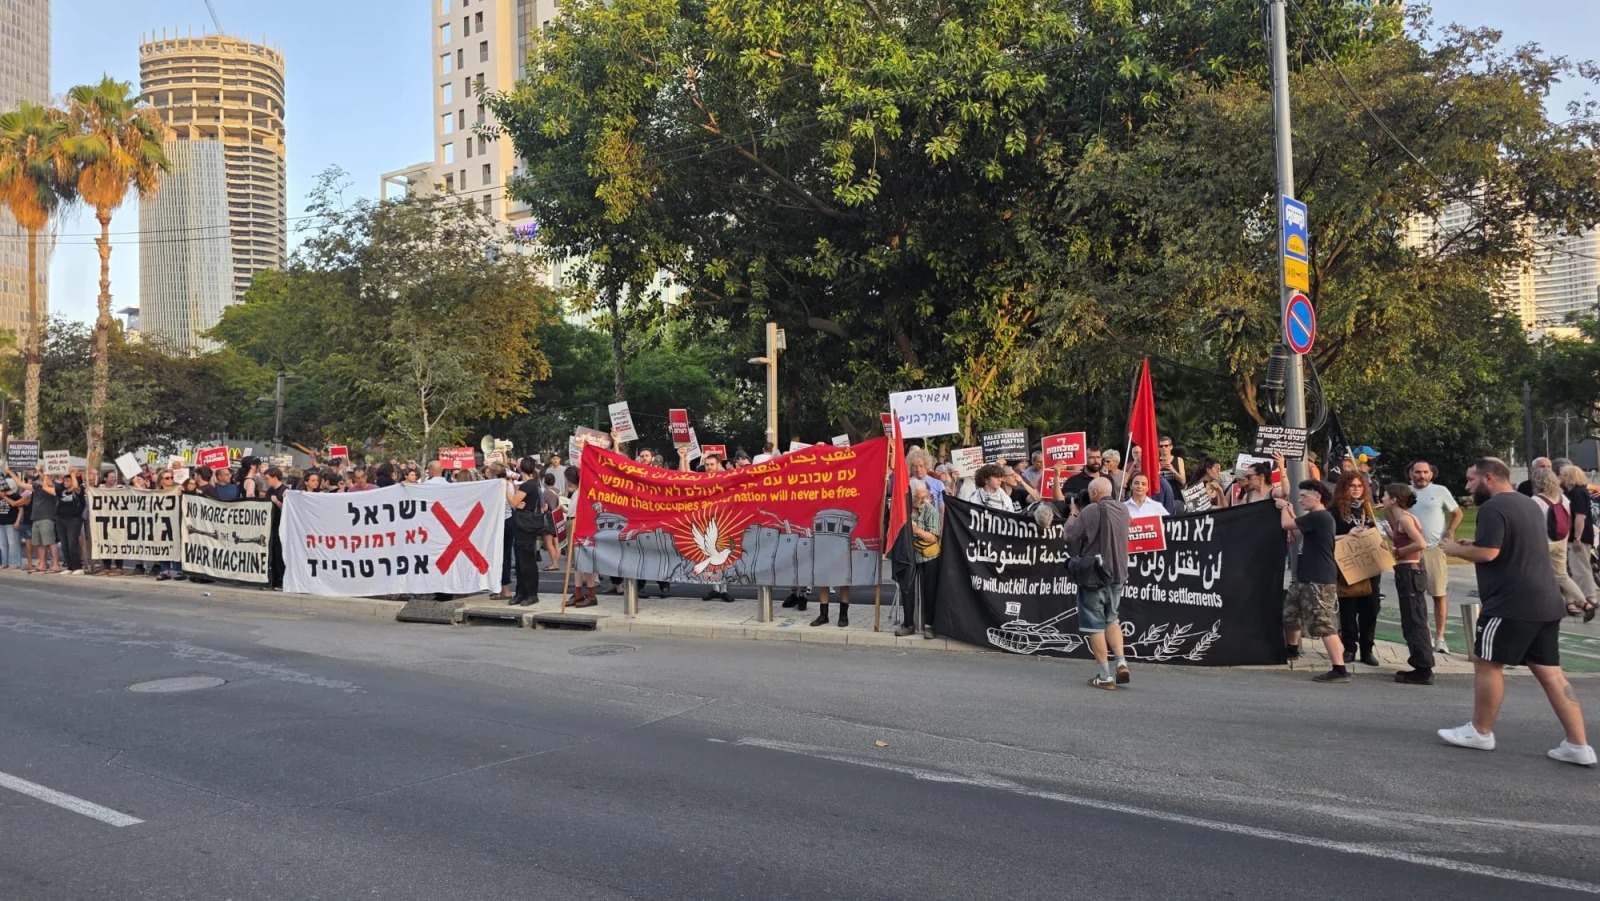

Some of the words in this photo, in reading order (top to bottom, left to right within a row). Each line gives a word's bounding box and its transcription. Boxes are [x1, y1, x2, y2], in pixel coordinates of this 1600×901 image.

[904, 393, 950, 404] משמידים
[983, 432, 1024, 442] PALESTINIAN
[1258, 426, 1284, 434] לכיבוש
[763, 476, 782, 486] עם
[787, 475, 833, 485] שכובש
[838, 468, 857, 481] עם
[587, 487, 599, 500] A
[598, 490, 630, 507] nation
[631, 494, 654, 511] that
[653, 502, 699, 513] occupies
[733, 491, 767, 503] nation
[769, 489, 788, 501] will
[790, 489, 820, 501] never
[821, 485, 836, 499] be
[665, 484, 681, 497] לא
[686, 483, 723, 497] לעולם
[92, 495, 147, 511] מייצאים
[149, 495, 176, 513] כאן
[347, 499, 427, 526] ישראל
[186, 502, 198, 519] NO
[200, 503, 227, 524] MORE
[227, 508, 268, 526] FEEDING
[968, 508, 1039, 538] ההתנחלות
[220, 532, 230, 541] THE
[405, 526, 428, 544] לא
[1128, 531, 1158, 541] המתנח
[1166, 520, 1189, 541] נמי
[1193, 514, 1214, 541] לא
[306, 531, 396, 554] דמוקרטיה
[184, 542, 211, 567] WAR
[212, 547, 267, 574] MACHINE
[966, 540, 1038, 574] المستوطنات
[1039, 544, 1071, 564] خدمة
[307, 554, 429, 578] אפרטהייד
[1168, 550, 1201, 582] نقتل
[1202, 551, 1222, 590] لن
[971, 575, 982, 591] We
[983, 576, 998, 593] will
[998, 578, 1014, 594] not
[1013, 577, 1028, 595] kill
[1029, 582, 1040, 595] or
[1040, 578, 1052, 595] be
[1140, 583, 1153, 601] of
[1152, 584, 1167, 603] the
[1168, 588, 1223, 608] settlements
